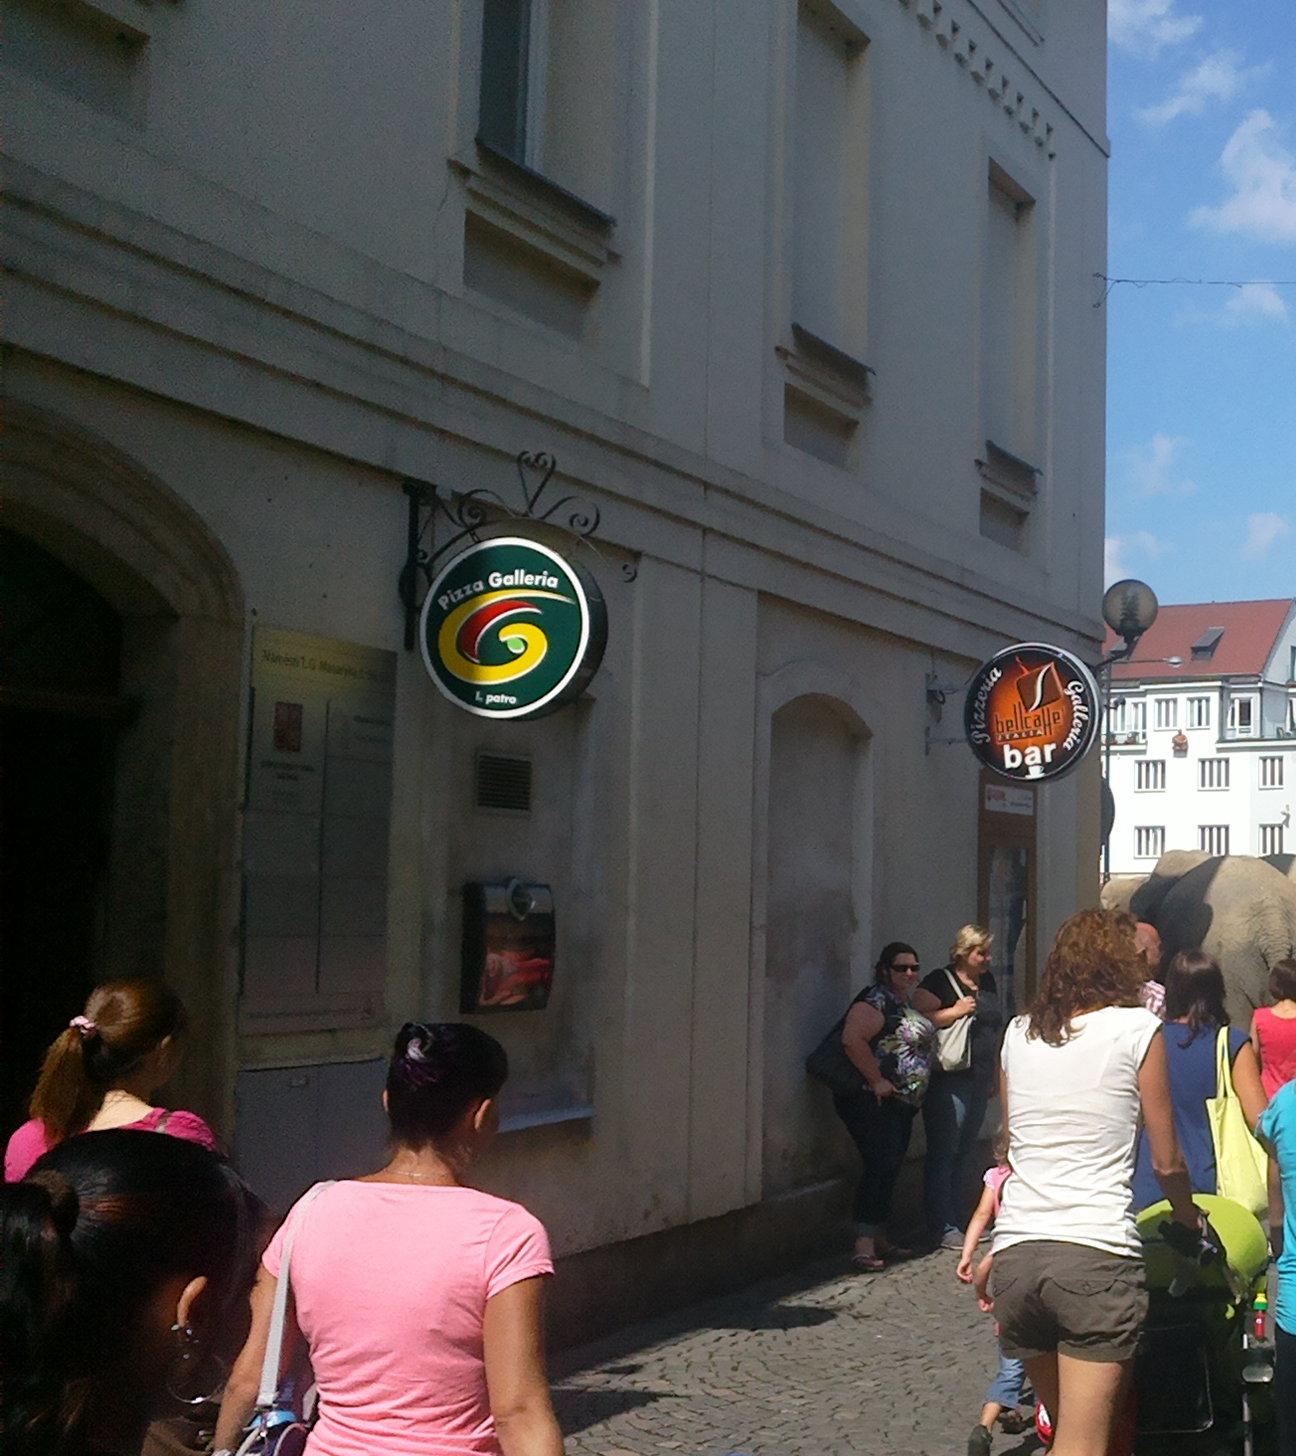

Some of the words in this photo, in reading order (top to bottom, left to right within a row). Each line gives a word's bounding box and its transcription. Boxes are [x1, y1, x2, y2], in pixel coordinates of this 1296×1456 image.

[437, 578, 484, 610] Pizza
[488, 569, 559, 588] Galleria
[485, 692, 517, 705] patro
[1003, 741, 1057, 769] bar
